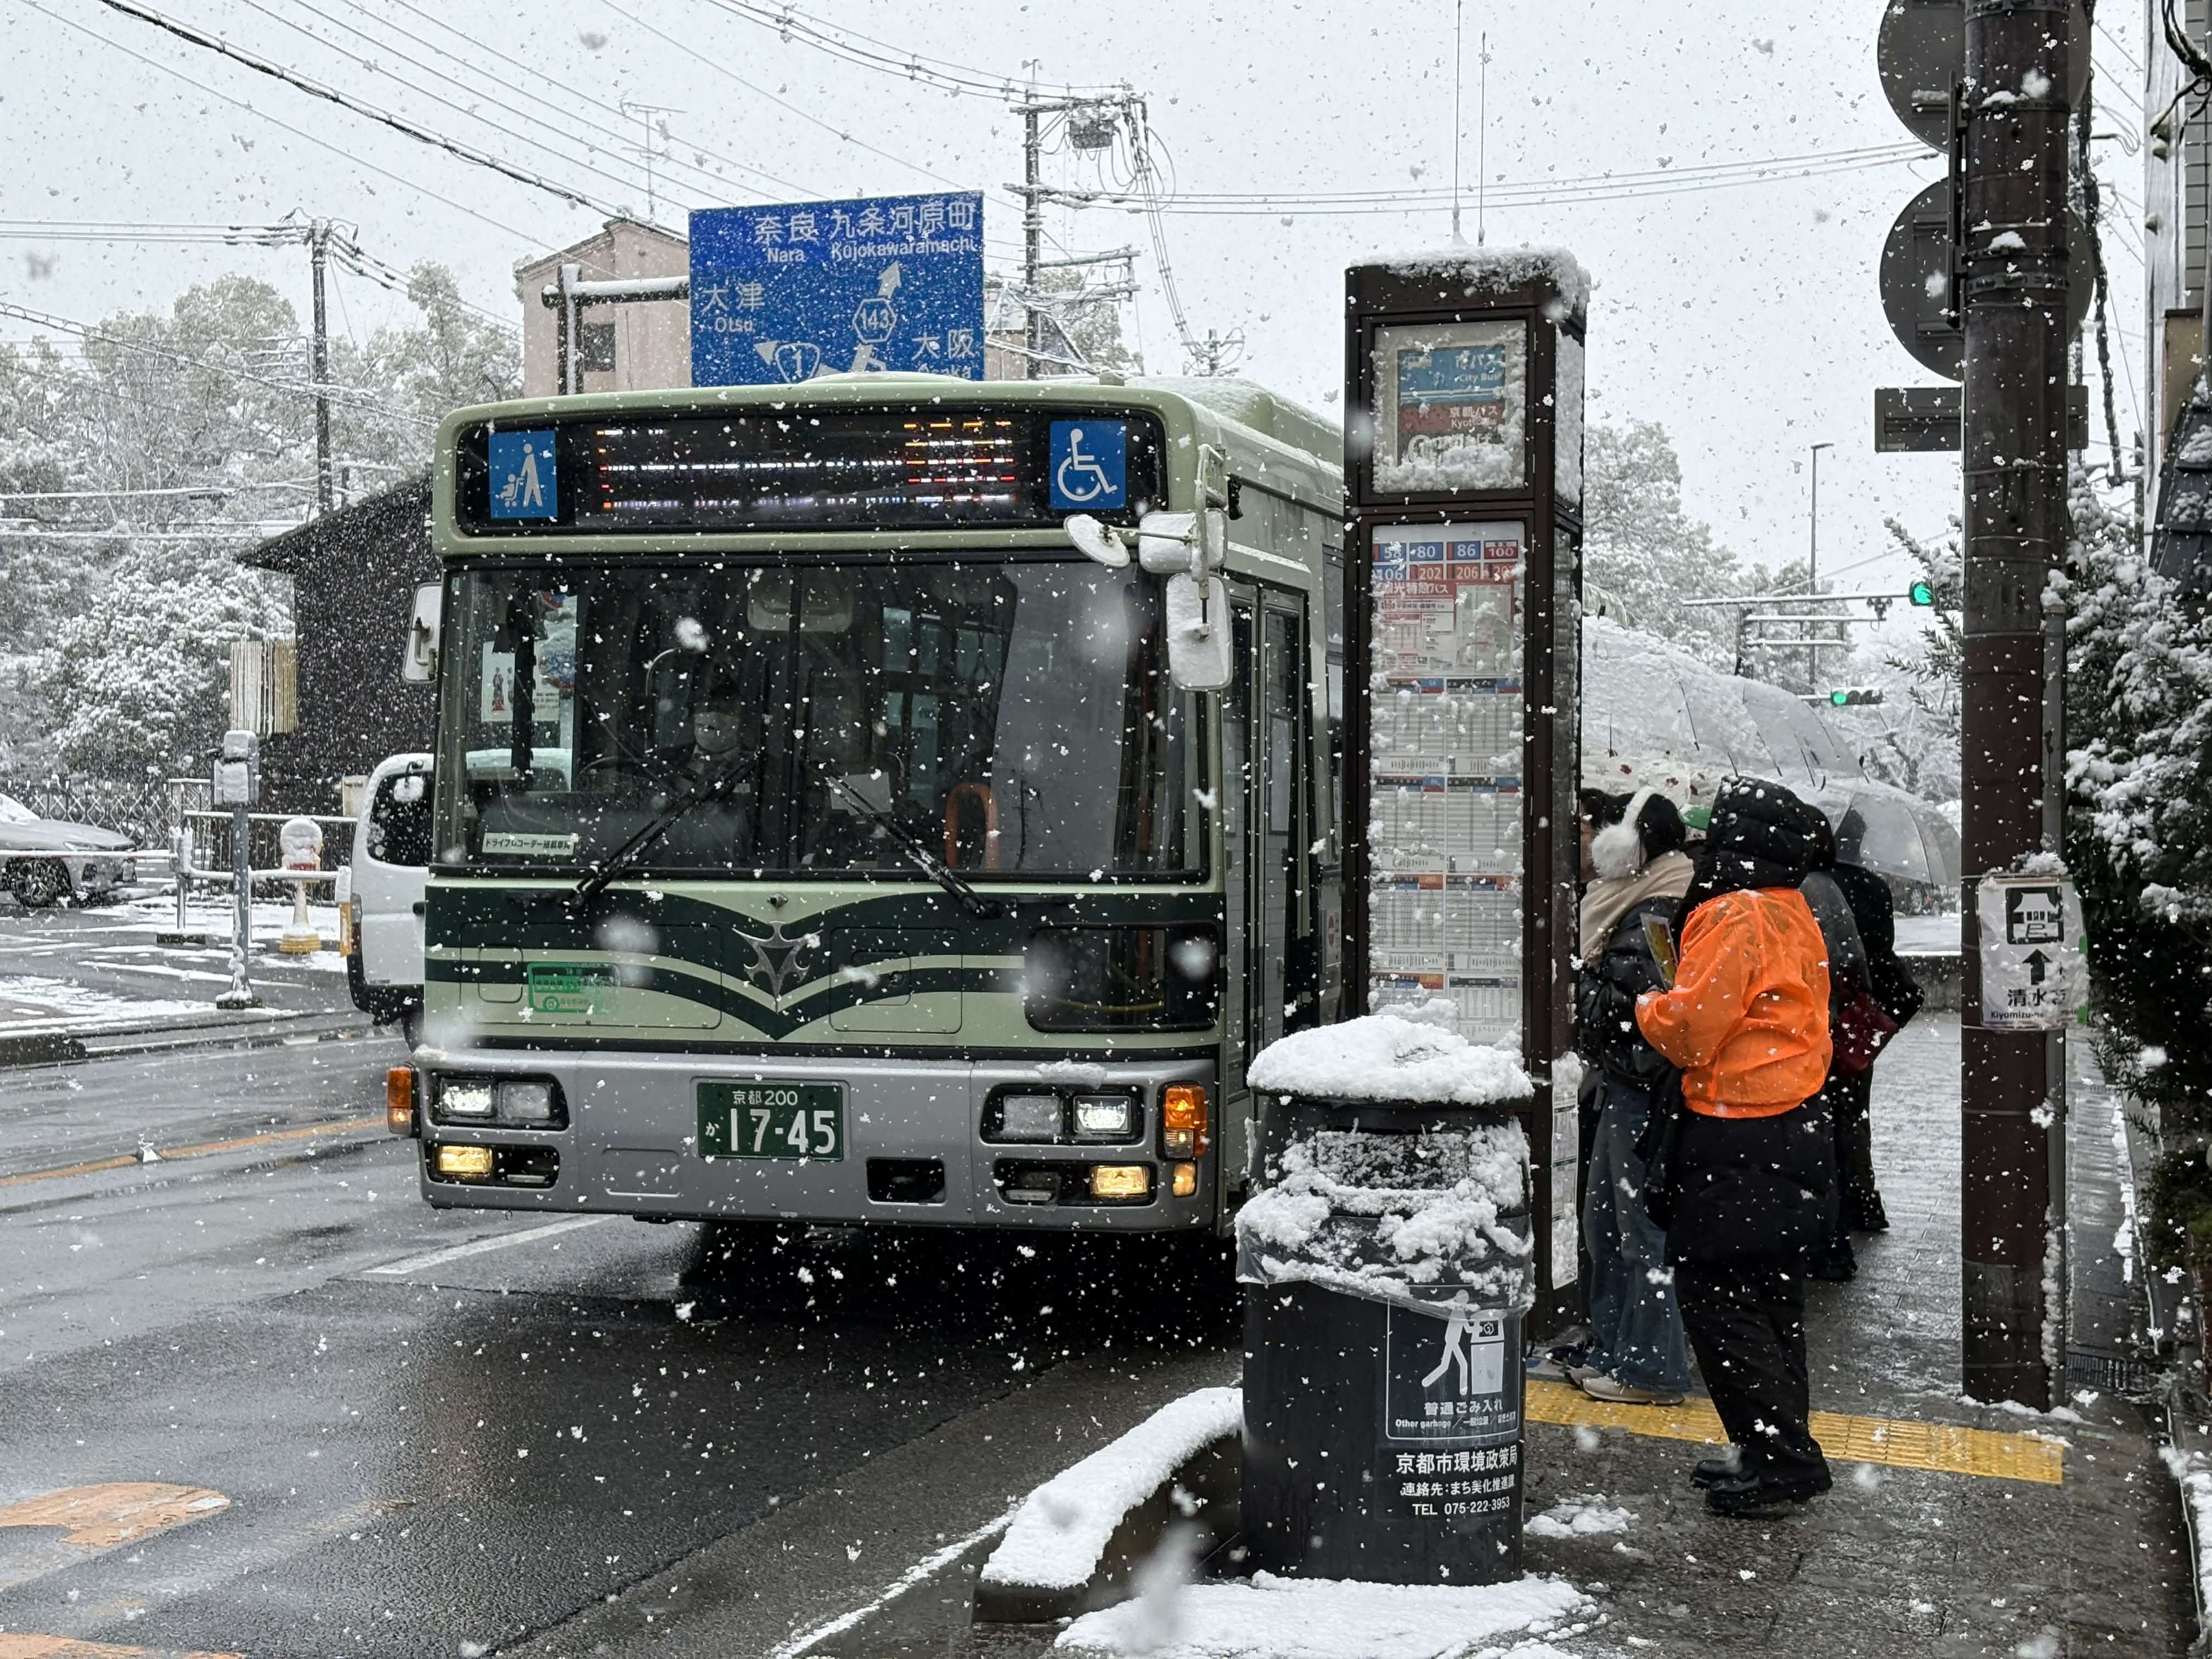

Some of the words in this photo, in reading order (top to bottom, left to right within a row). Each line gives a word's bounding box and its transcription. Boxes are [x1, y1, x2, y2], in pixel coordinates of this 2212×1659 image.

[754, 212, 819, 246] 奈良
[829, 201, 975, 239] 九条河原町
[768, 247, 805, 263] Nara
[702, 281, 765, 313] 大津
[715, 317, 753, 332] Otsu
[859, 307, 889, 330] 143
[911, 328, 975, 360] 大阪
[1451, 419, 1480, 430] Kyot
[1417, 545, 1436, 558] 80
[1457, 544, 1476, 557] 86
[1488, 547, 1514, 557] 100
[1419, 567, 1441, 580] 202
[1457, 566, 1479, 579] 206
[705, 1121, 720, 1137] か
[730, 1108, 836, 1153] 17-45
[1424, 1398, 1503, 1416] 普通ごみ入れ
[1396, 1419, 1418, 1427] Other
[1420, 1420, 1451, 1429] garbage
[1396, 1445, 1517, 1474] 京都市環境政策局
[1412, 1504, 1438, 1515] TEL
[1444, 1496, 1510, 1514] 075-222-3953
